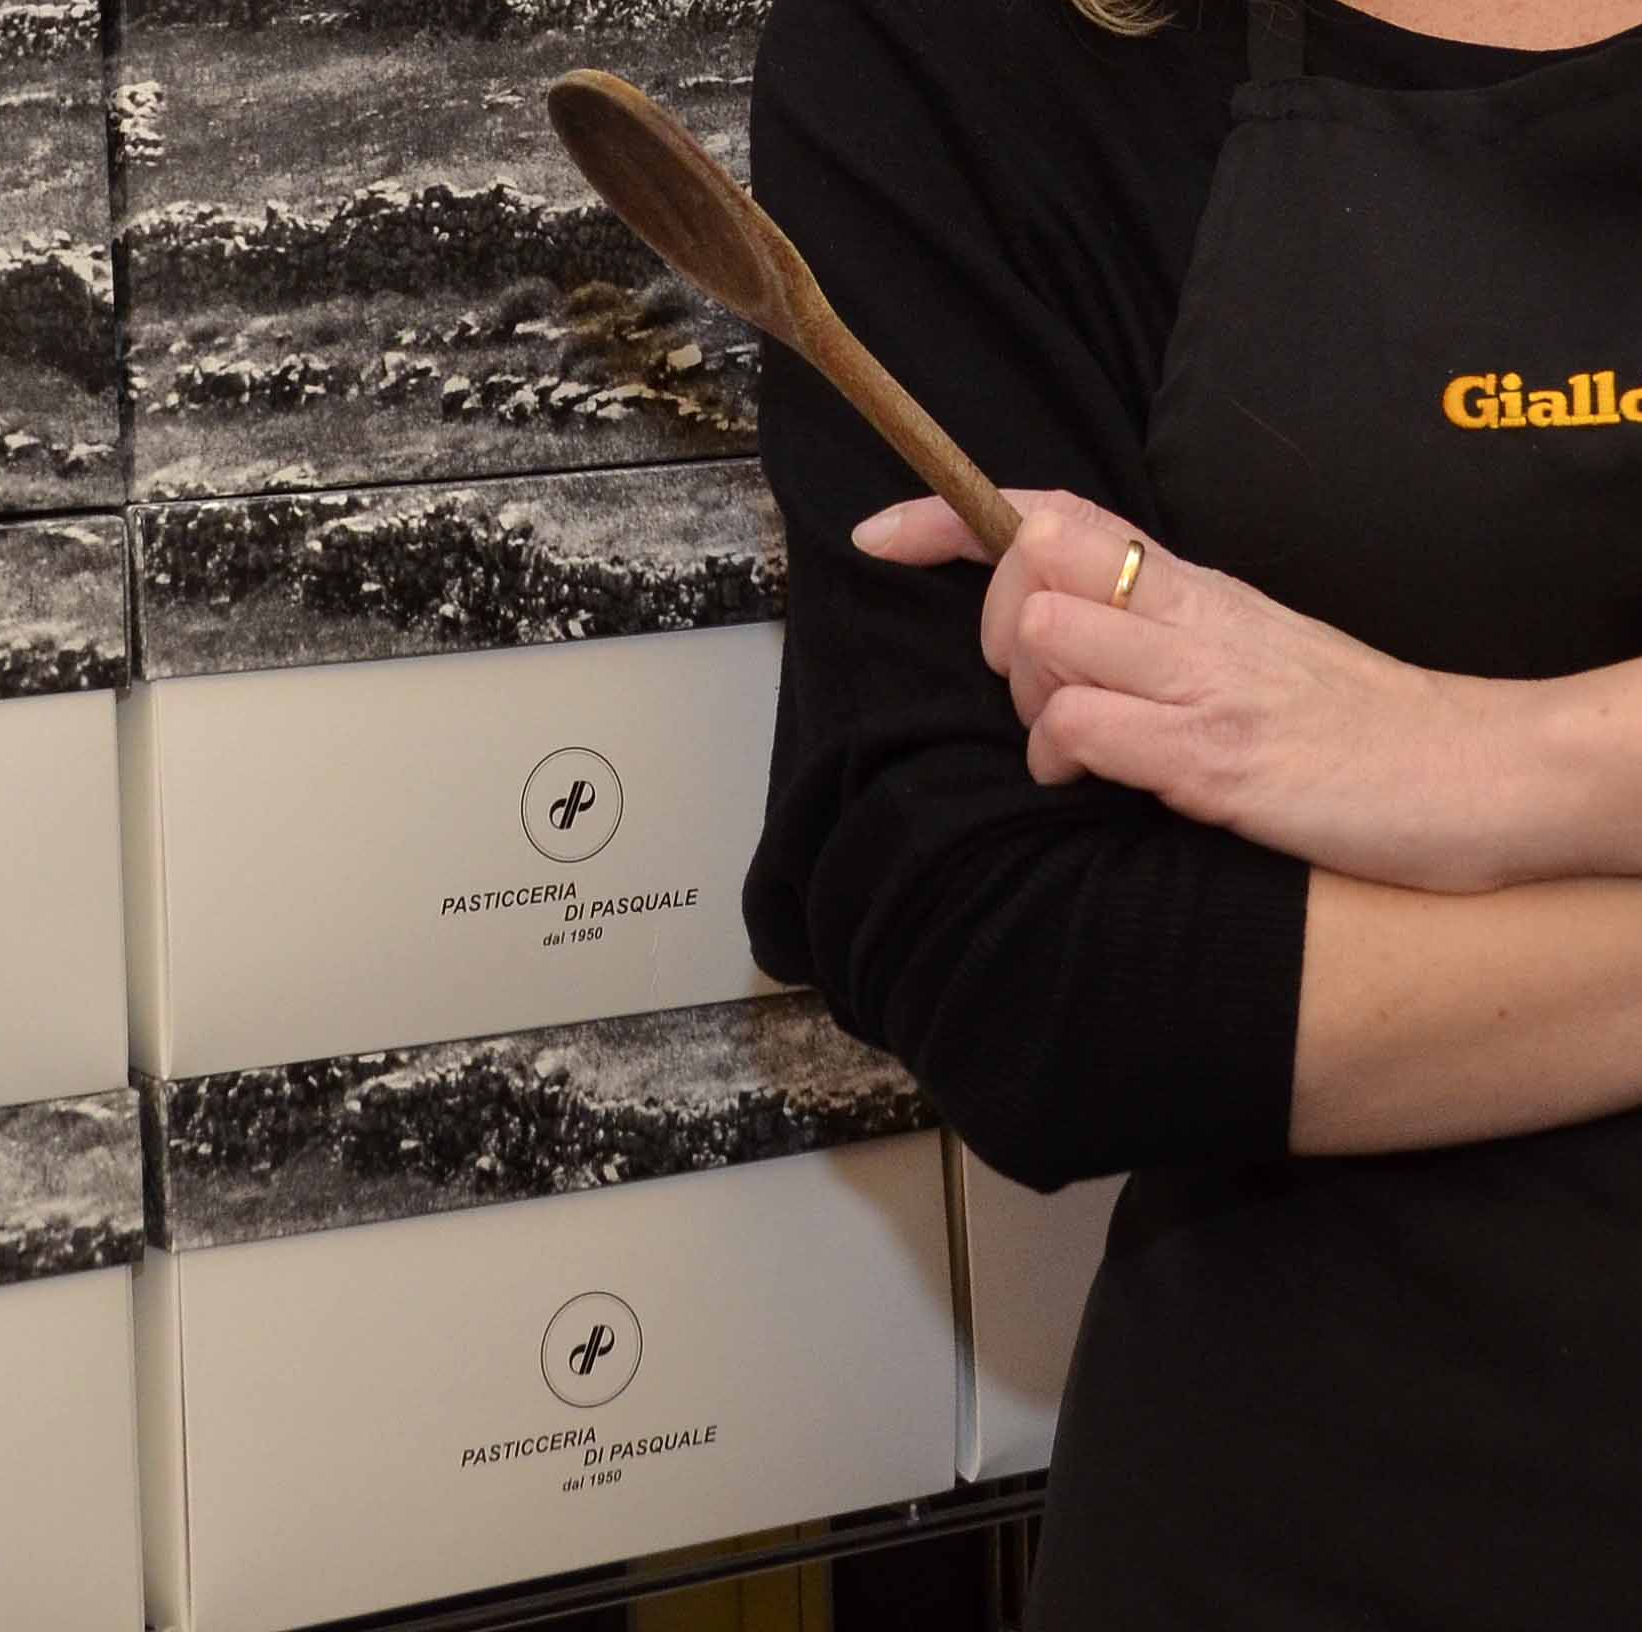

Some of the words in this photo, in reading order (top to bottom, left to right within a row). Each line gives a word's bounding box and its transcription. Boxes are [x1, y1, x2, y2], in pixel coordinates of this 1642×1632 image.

[441, 882, 578, 916] PASTICCERIA
[564, 904, 584, 922] DI
[590, 888, 699, 920] PASQUALE
[543, 931, 565, 947] dal
[570, 926, 603, 944] 1950
[461, 1426, 596, 1468] PASTICCERIA
[583, 1448, 603, 1467] DI
[609, 1424, 718, 1462] PASQUALE
[562, 1474, 585, 1492] dal
[589, 1469, 622, 1487] 1950
